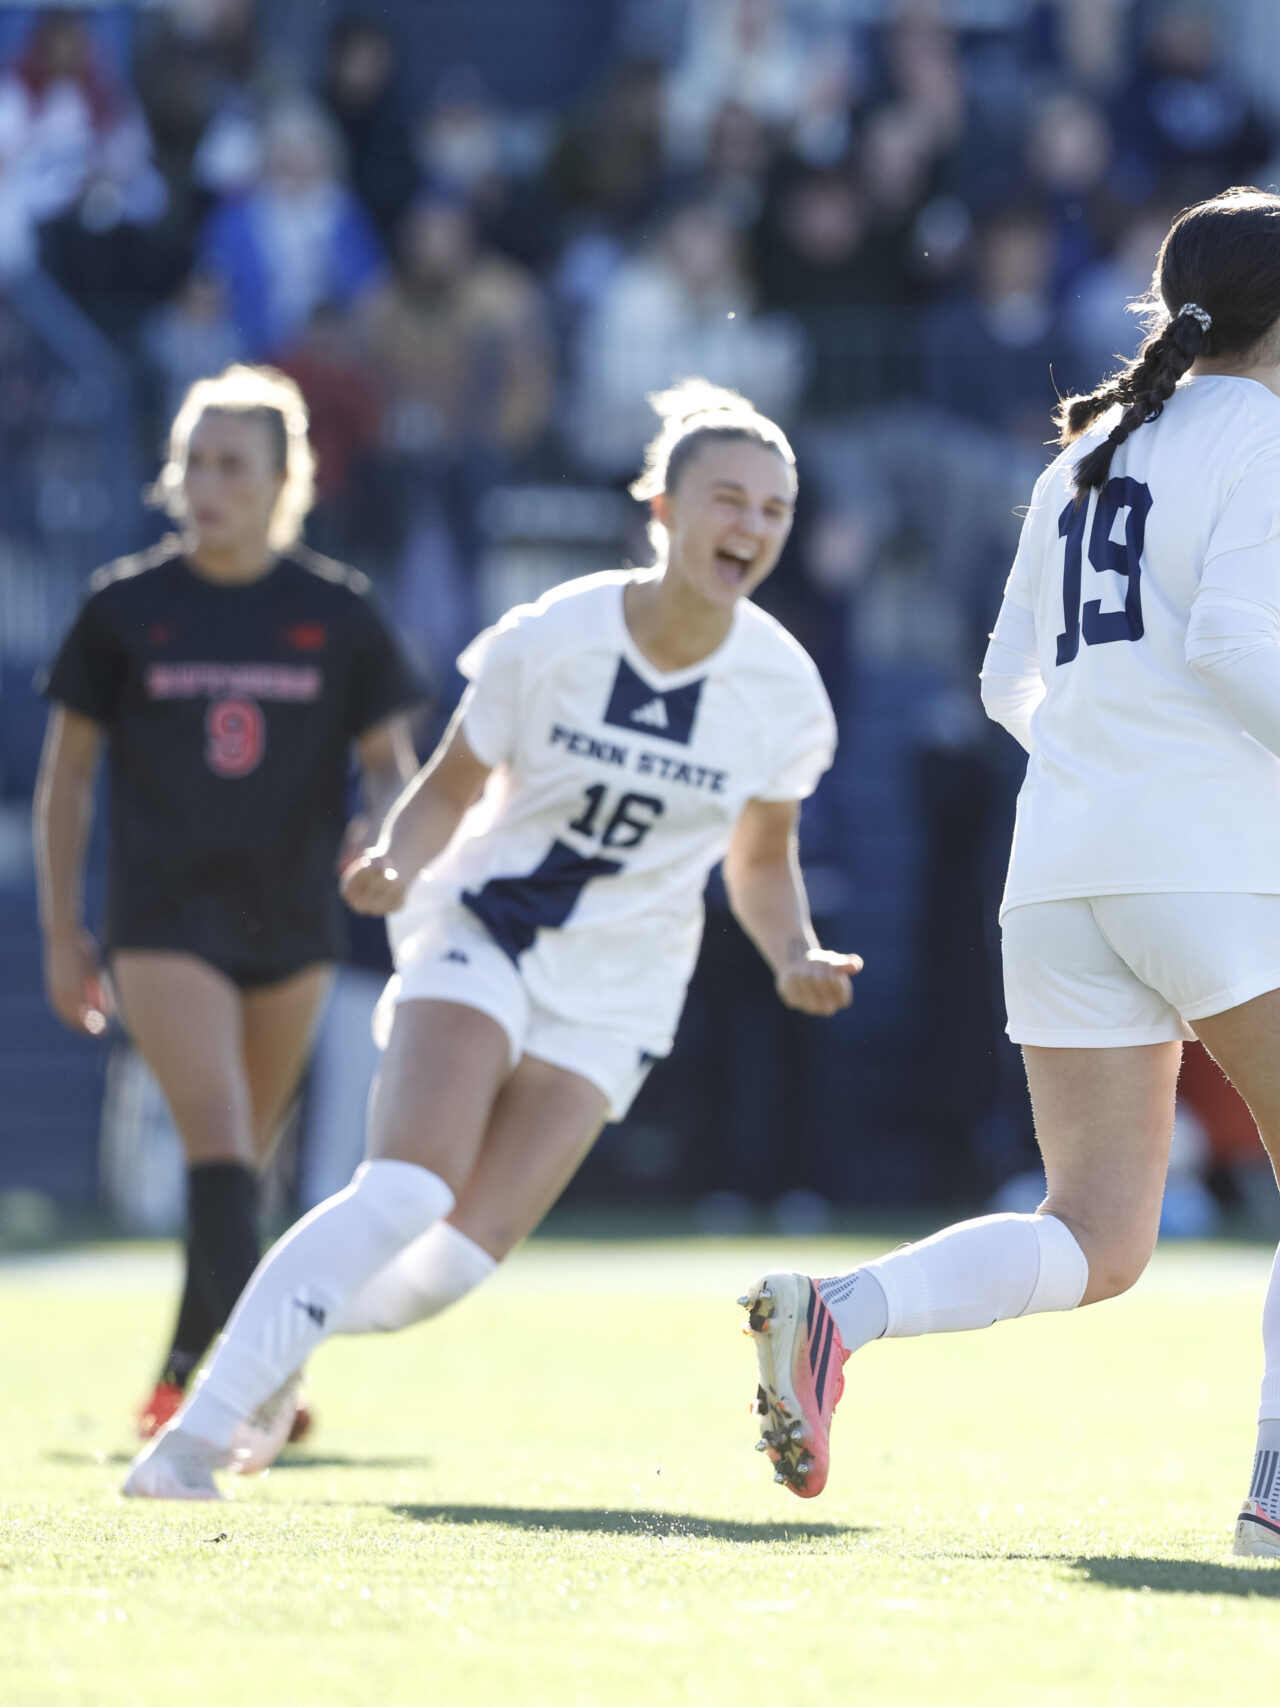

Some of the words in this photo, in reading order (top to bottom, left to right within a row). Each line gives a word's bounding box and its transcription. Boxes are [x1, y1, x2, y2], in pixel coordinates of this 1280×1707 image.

[1056, 476, 1153, 667] 19
[206, 698, 266, 778] 9
[551, 723, 627, 768] PENN
[637, 752, 729, 793] STATE
[569, 782, 665, 848] 16
